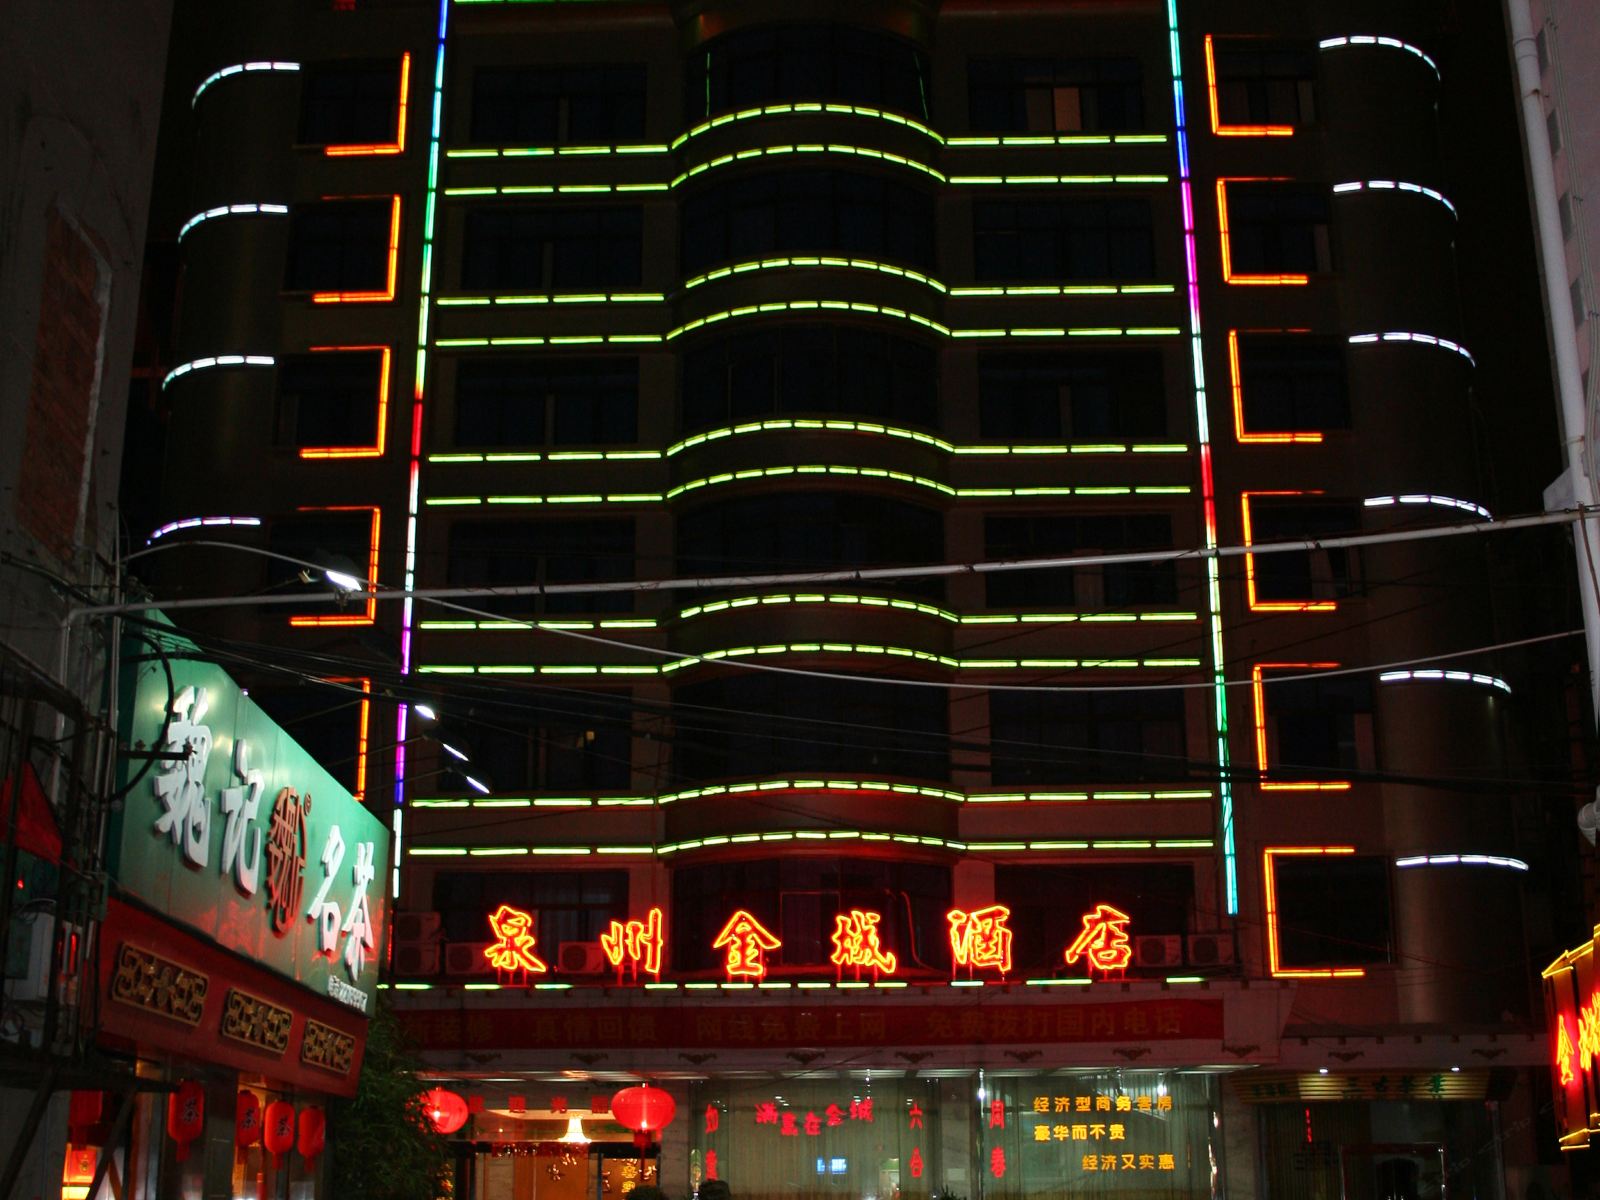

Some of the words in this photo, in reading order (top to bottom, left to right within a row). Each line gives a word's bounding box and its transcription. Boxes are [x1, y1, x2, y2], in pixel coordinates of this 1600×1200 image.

[307, 824, 375, 981] 名茶
[483, 904, 1132, 977] 泉州金城酒店
[1033, 1094, 1173, 1113] 经济型商务客房
[1033, 1123, 1126, 1141] 豪华而不贵
[1081, 1153, 1175, 1171] 经济又实惠
